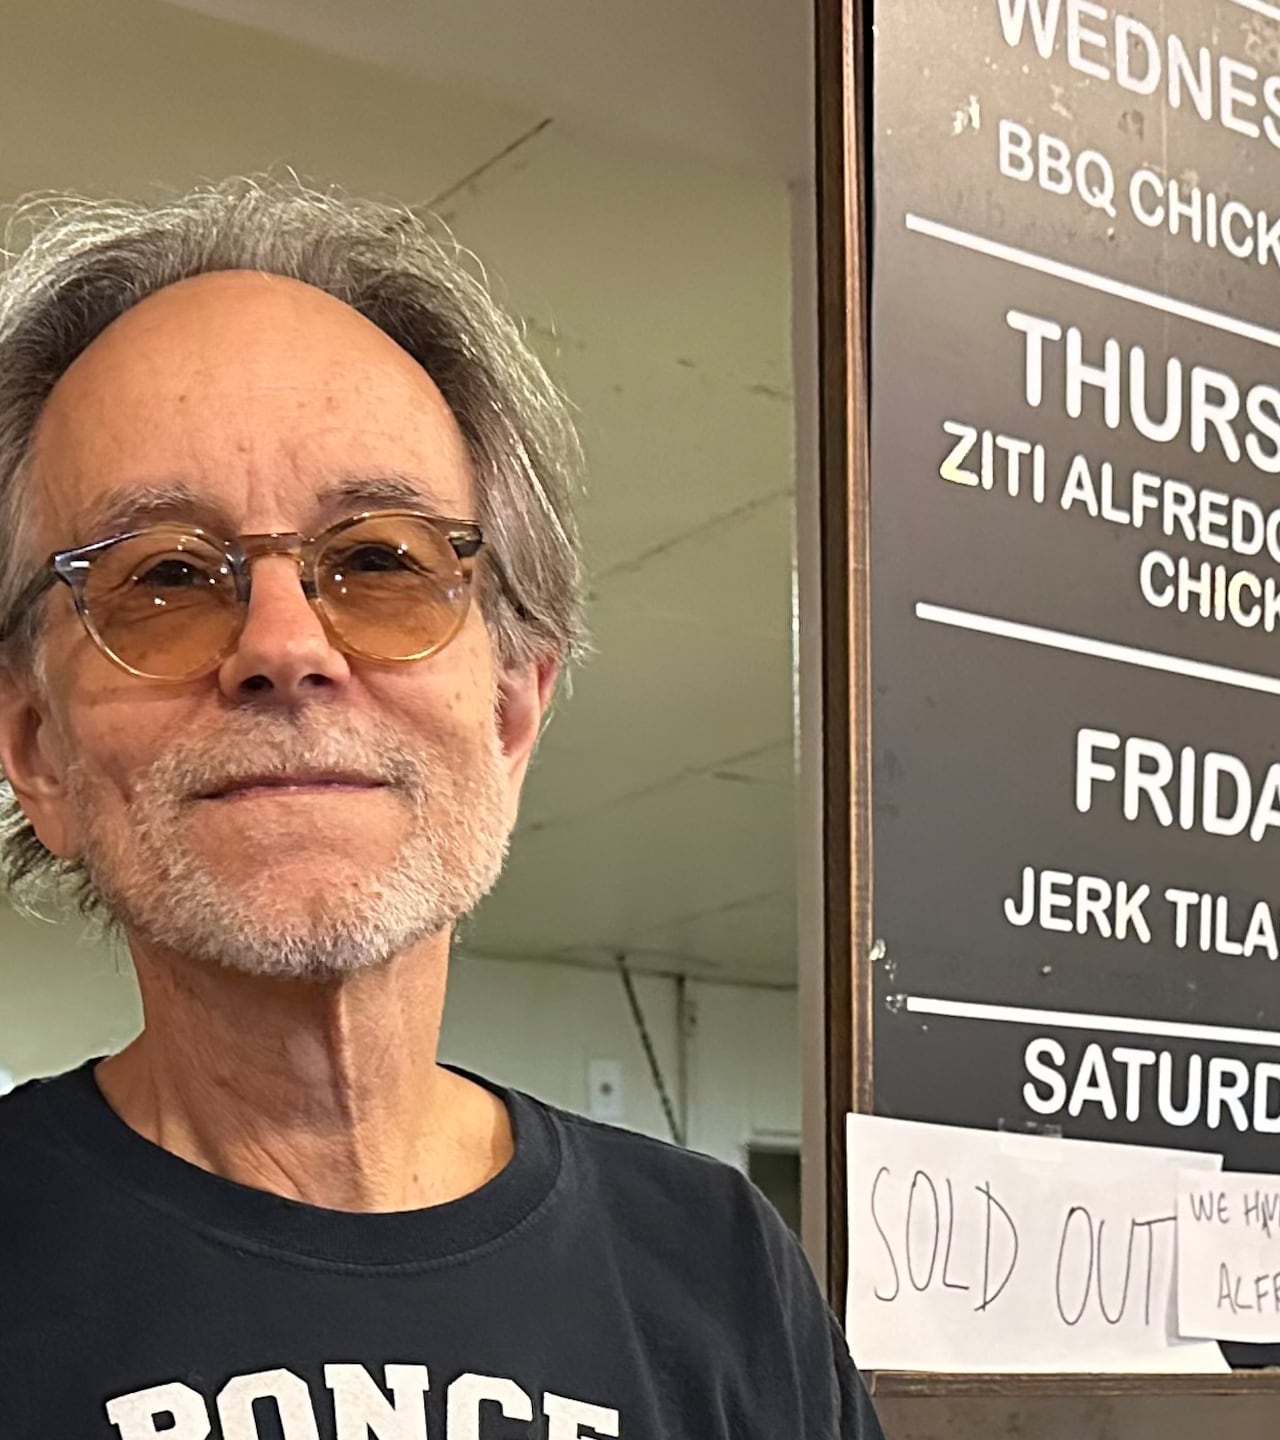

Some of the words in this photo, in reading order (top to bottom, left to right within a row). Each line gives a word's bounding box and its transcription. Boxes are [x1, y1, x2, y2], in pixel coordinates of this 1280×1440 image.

[998, 119, 1118, 217] BBQ
[939, 420, 1045, 503] ZITI
[1004, 866, 1152, 944] JERK
[871, 1166, 1018, 1312] SOLD
[1056, 1206, 1176, 1326] OUT
[1190, 1191, 1230, 1224] WE
